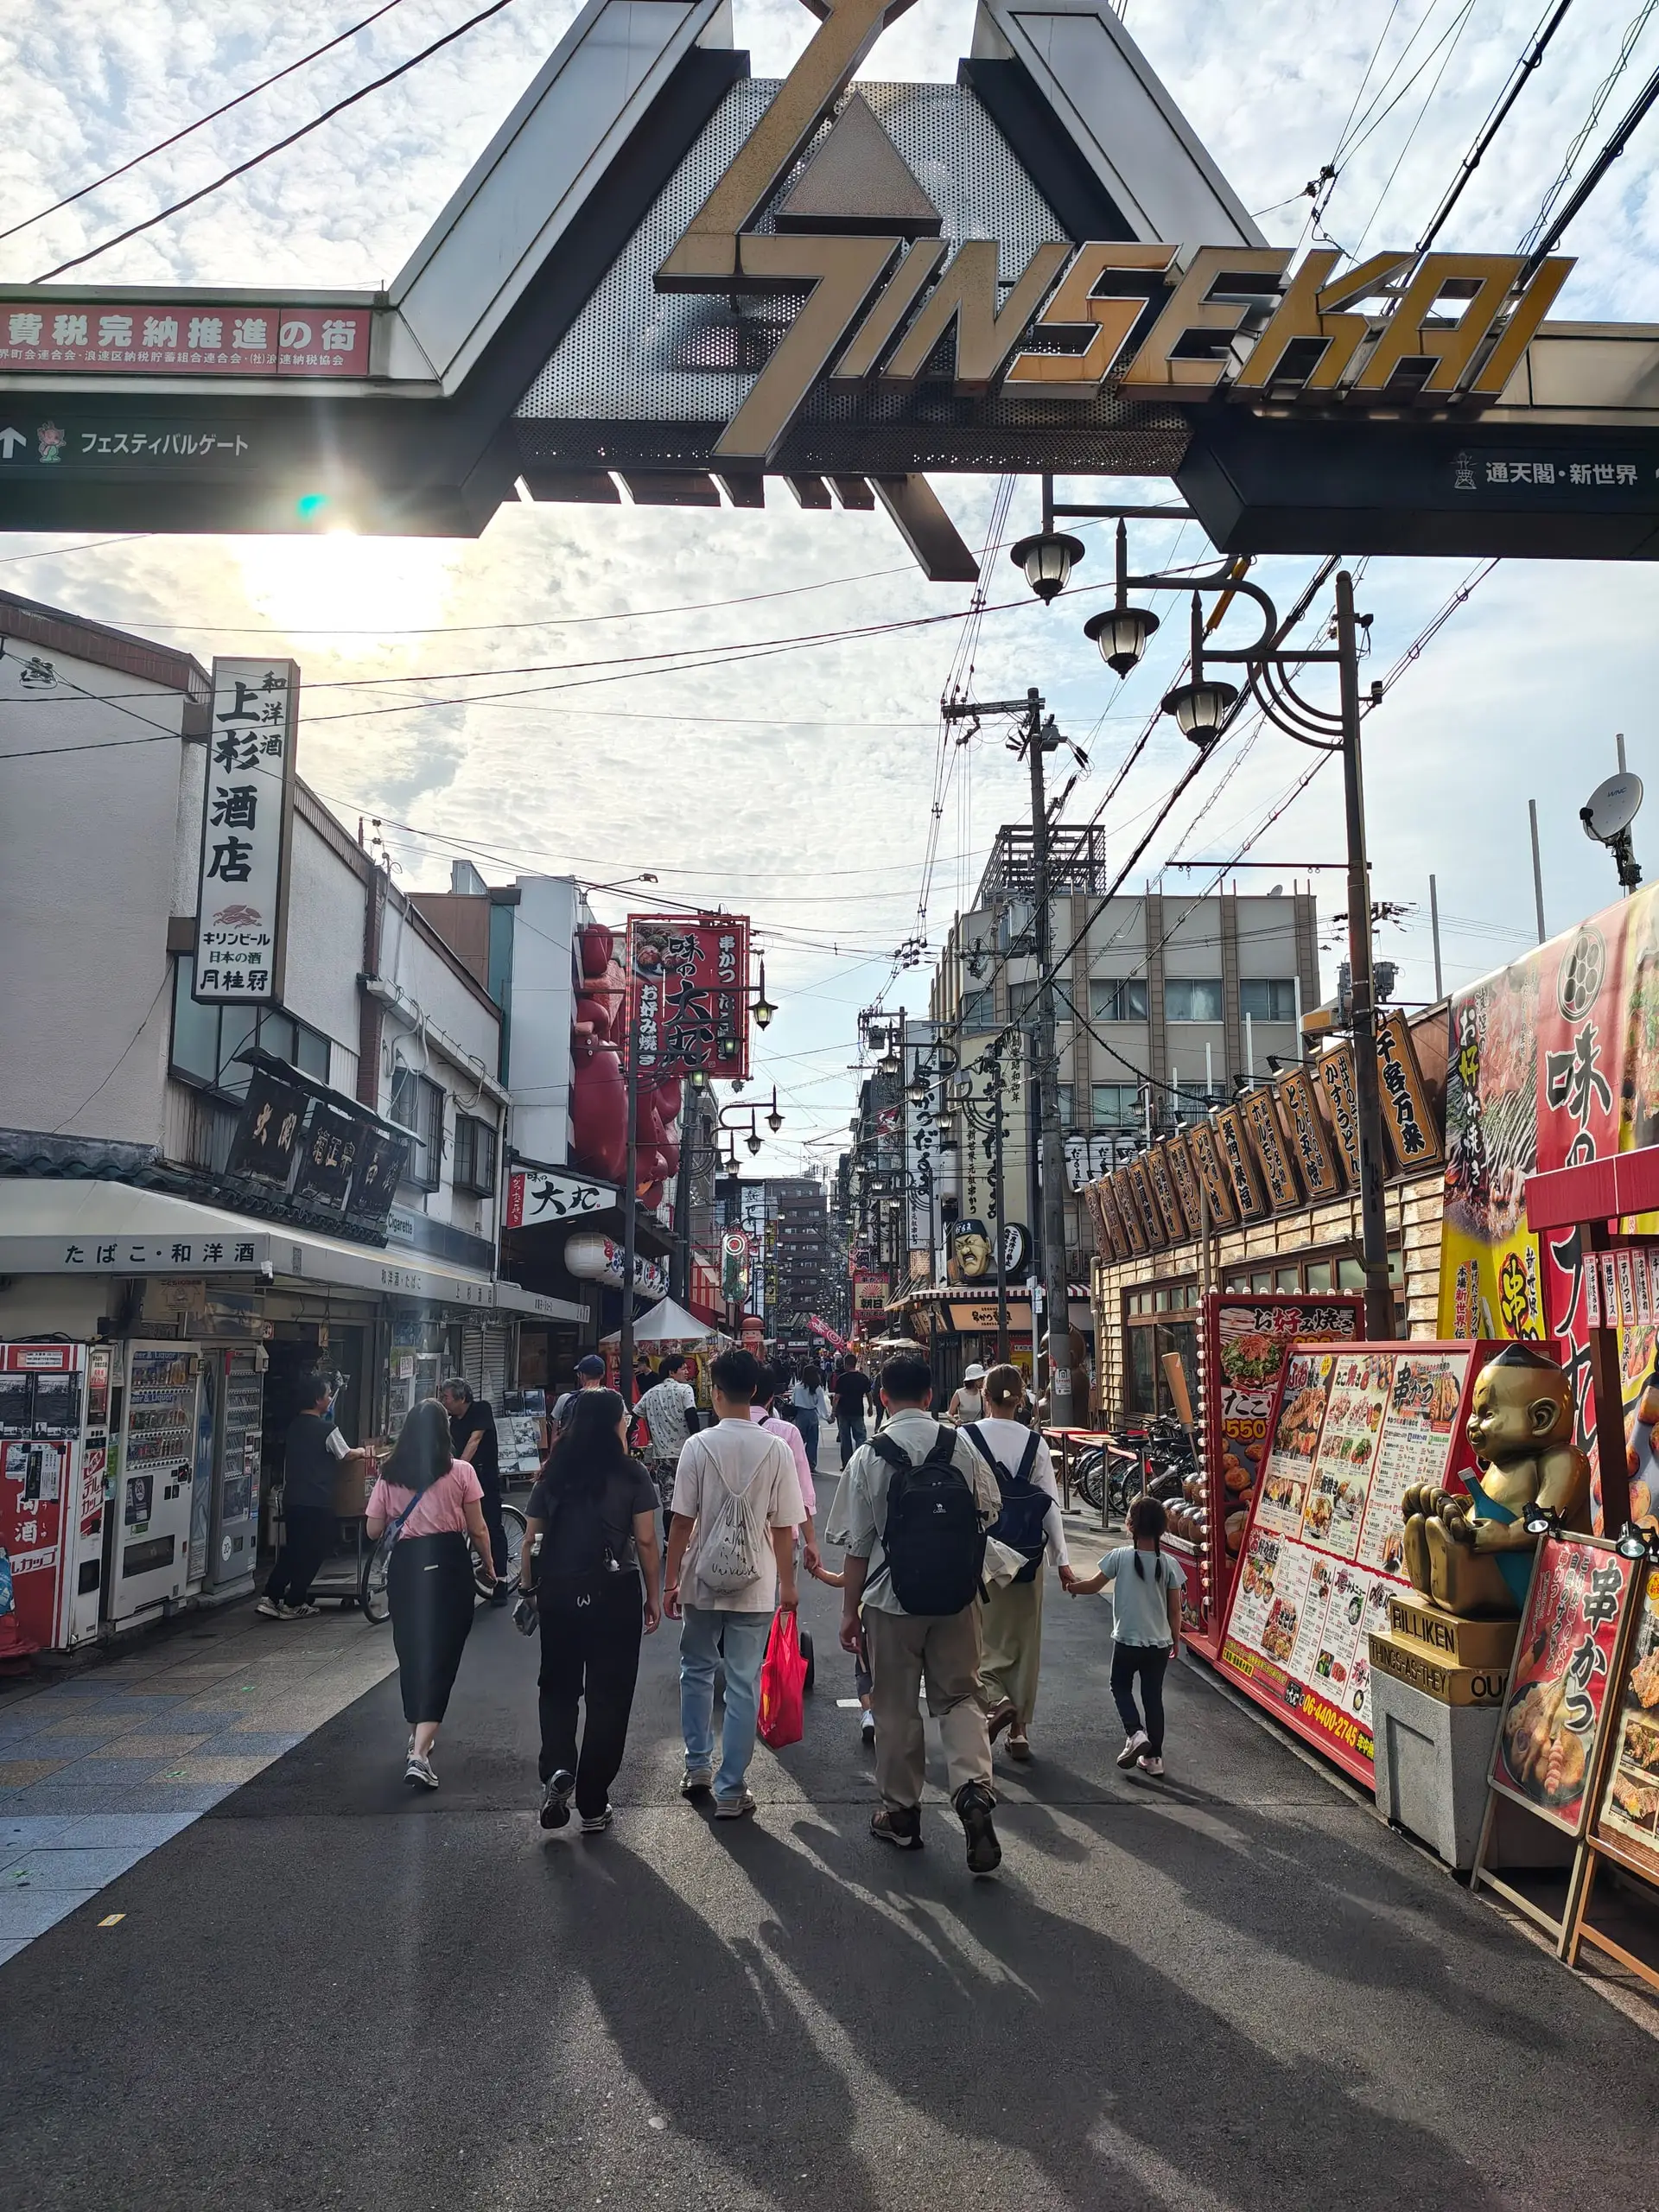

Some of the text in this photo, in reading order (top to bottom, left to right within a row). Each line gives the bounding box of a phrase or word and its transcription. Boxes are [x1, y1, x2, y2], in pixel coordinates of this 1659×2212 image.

[9, 313, 357, 352] 費税完納推進の街
[81, 433, 249, 456] フェスティバルゲート
[1485, 461, 1638, 486] 通天閣・新世界
[259, 671, 286, 759] 和洋酒
[207, 681, 261, 883] 上杉酒店
[203, 931, 270, 948] キリンビール
[209, 950, 262, 964] 日本の酒
[718, 935, 736, 984] 串かつ
[200, 969, 269, 992] 月桂冠
[639, 984, 659, 1066] お好み焼き
[1458, 1007, 1482, 1186] お好み焼き
[529, 1180, 601, 1216] 大丸
[64, 1243, 256, 1264] たばこ・和洋酒
[1526, 1246, 1538, 1323] 新世界
[1621, 1263, 1632, 1314] テリマヨ
[1254, 1306, 1355, 1335] お好み焼き
[1393, 1361, 1434, 1408] 串かつ
[1226, 1419, 1267, 1440] 550
[1392, 1605, 1456, 1654] BILLIKEN
[1563, 1557, 1624, 1732] 串かつ
[1370, 1641, 1446, 1694] THINGS-AS-THEY
